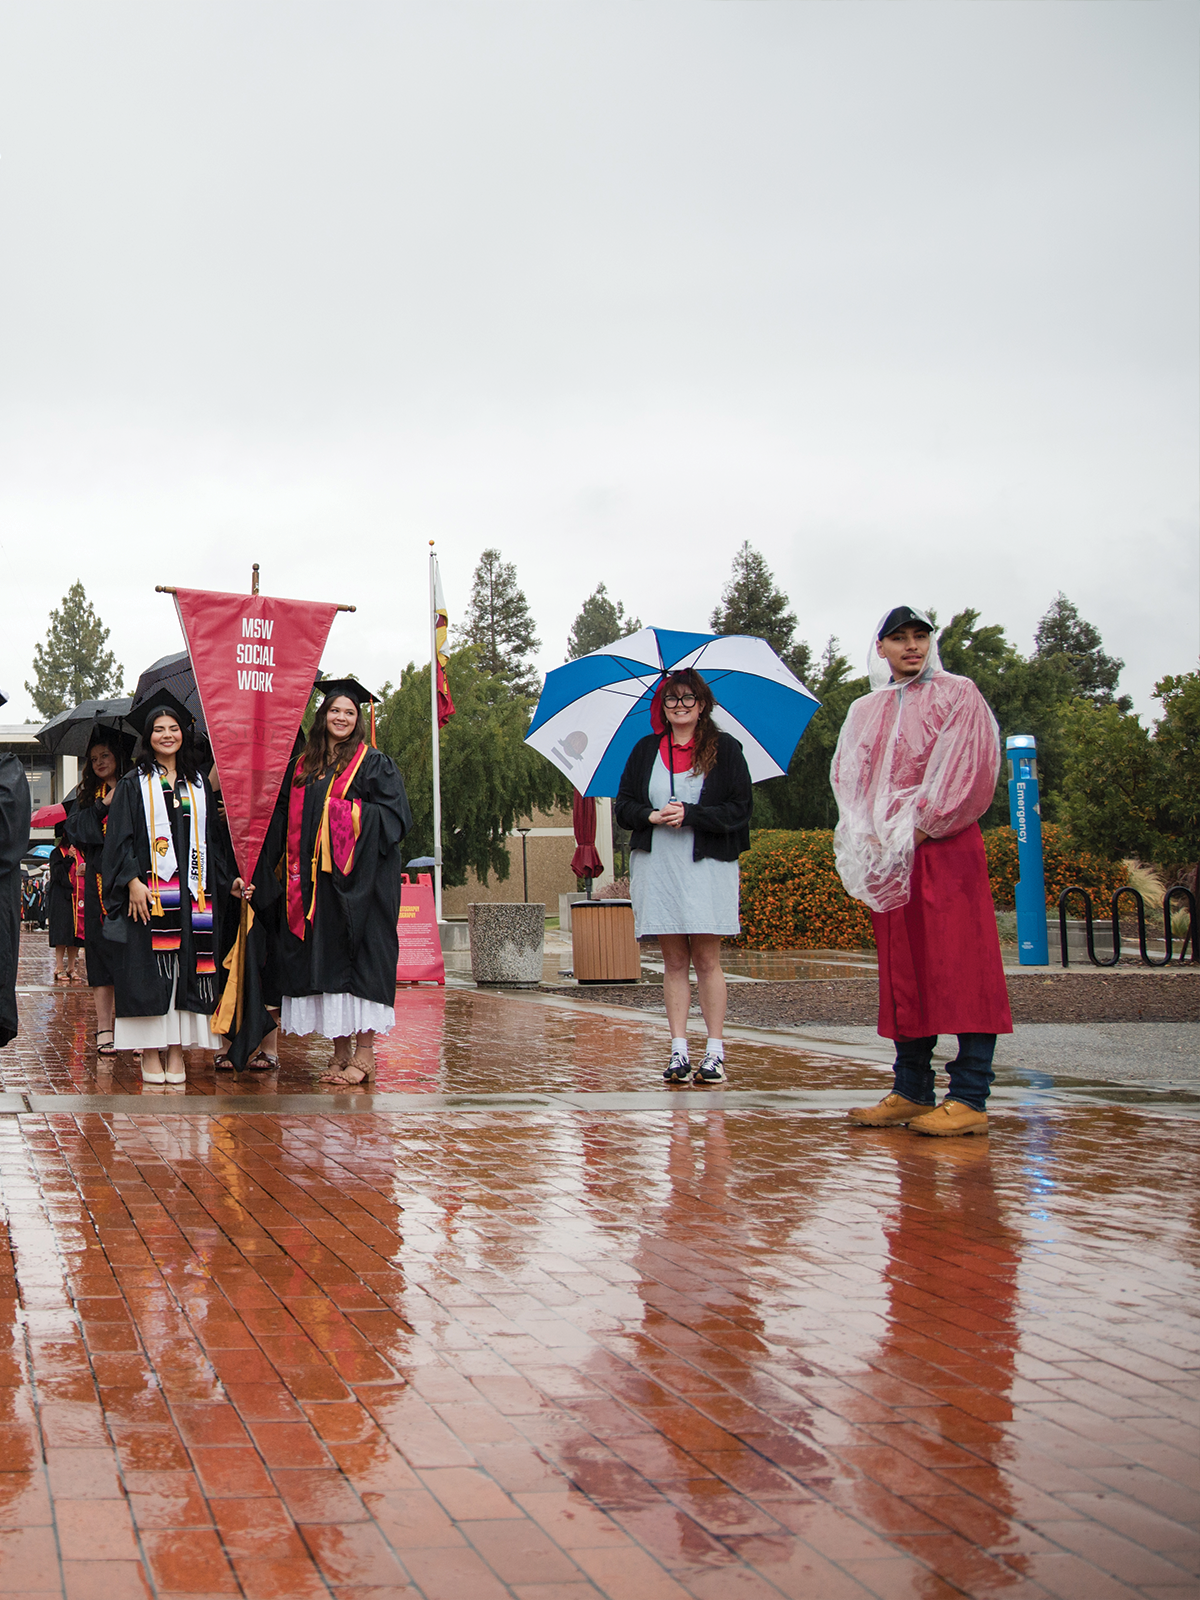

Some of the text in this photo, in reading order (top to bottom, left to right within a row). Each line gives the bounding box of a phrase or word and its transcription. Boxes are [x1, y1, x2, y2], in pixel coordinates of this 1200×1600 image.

[242, 618, 274, 640] MSW
[236, 644, 276, 667] SOCIAL
[237, 670, 273, 693] WORK
[1016, 782, 1027, 843] Emergency
